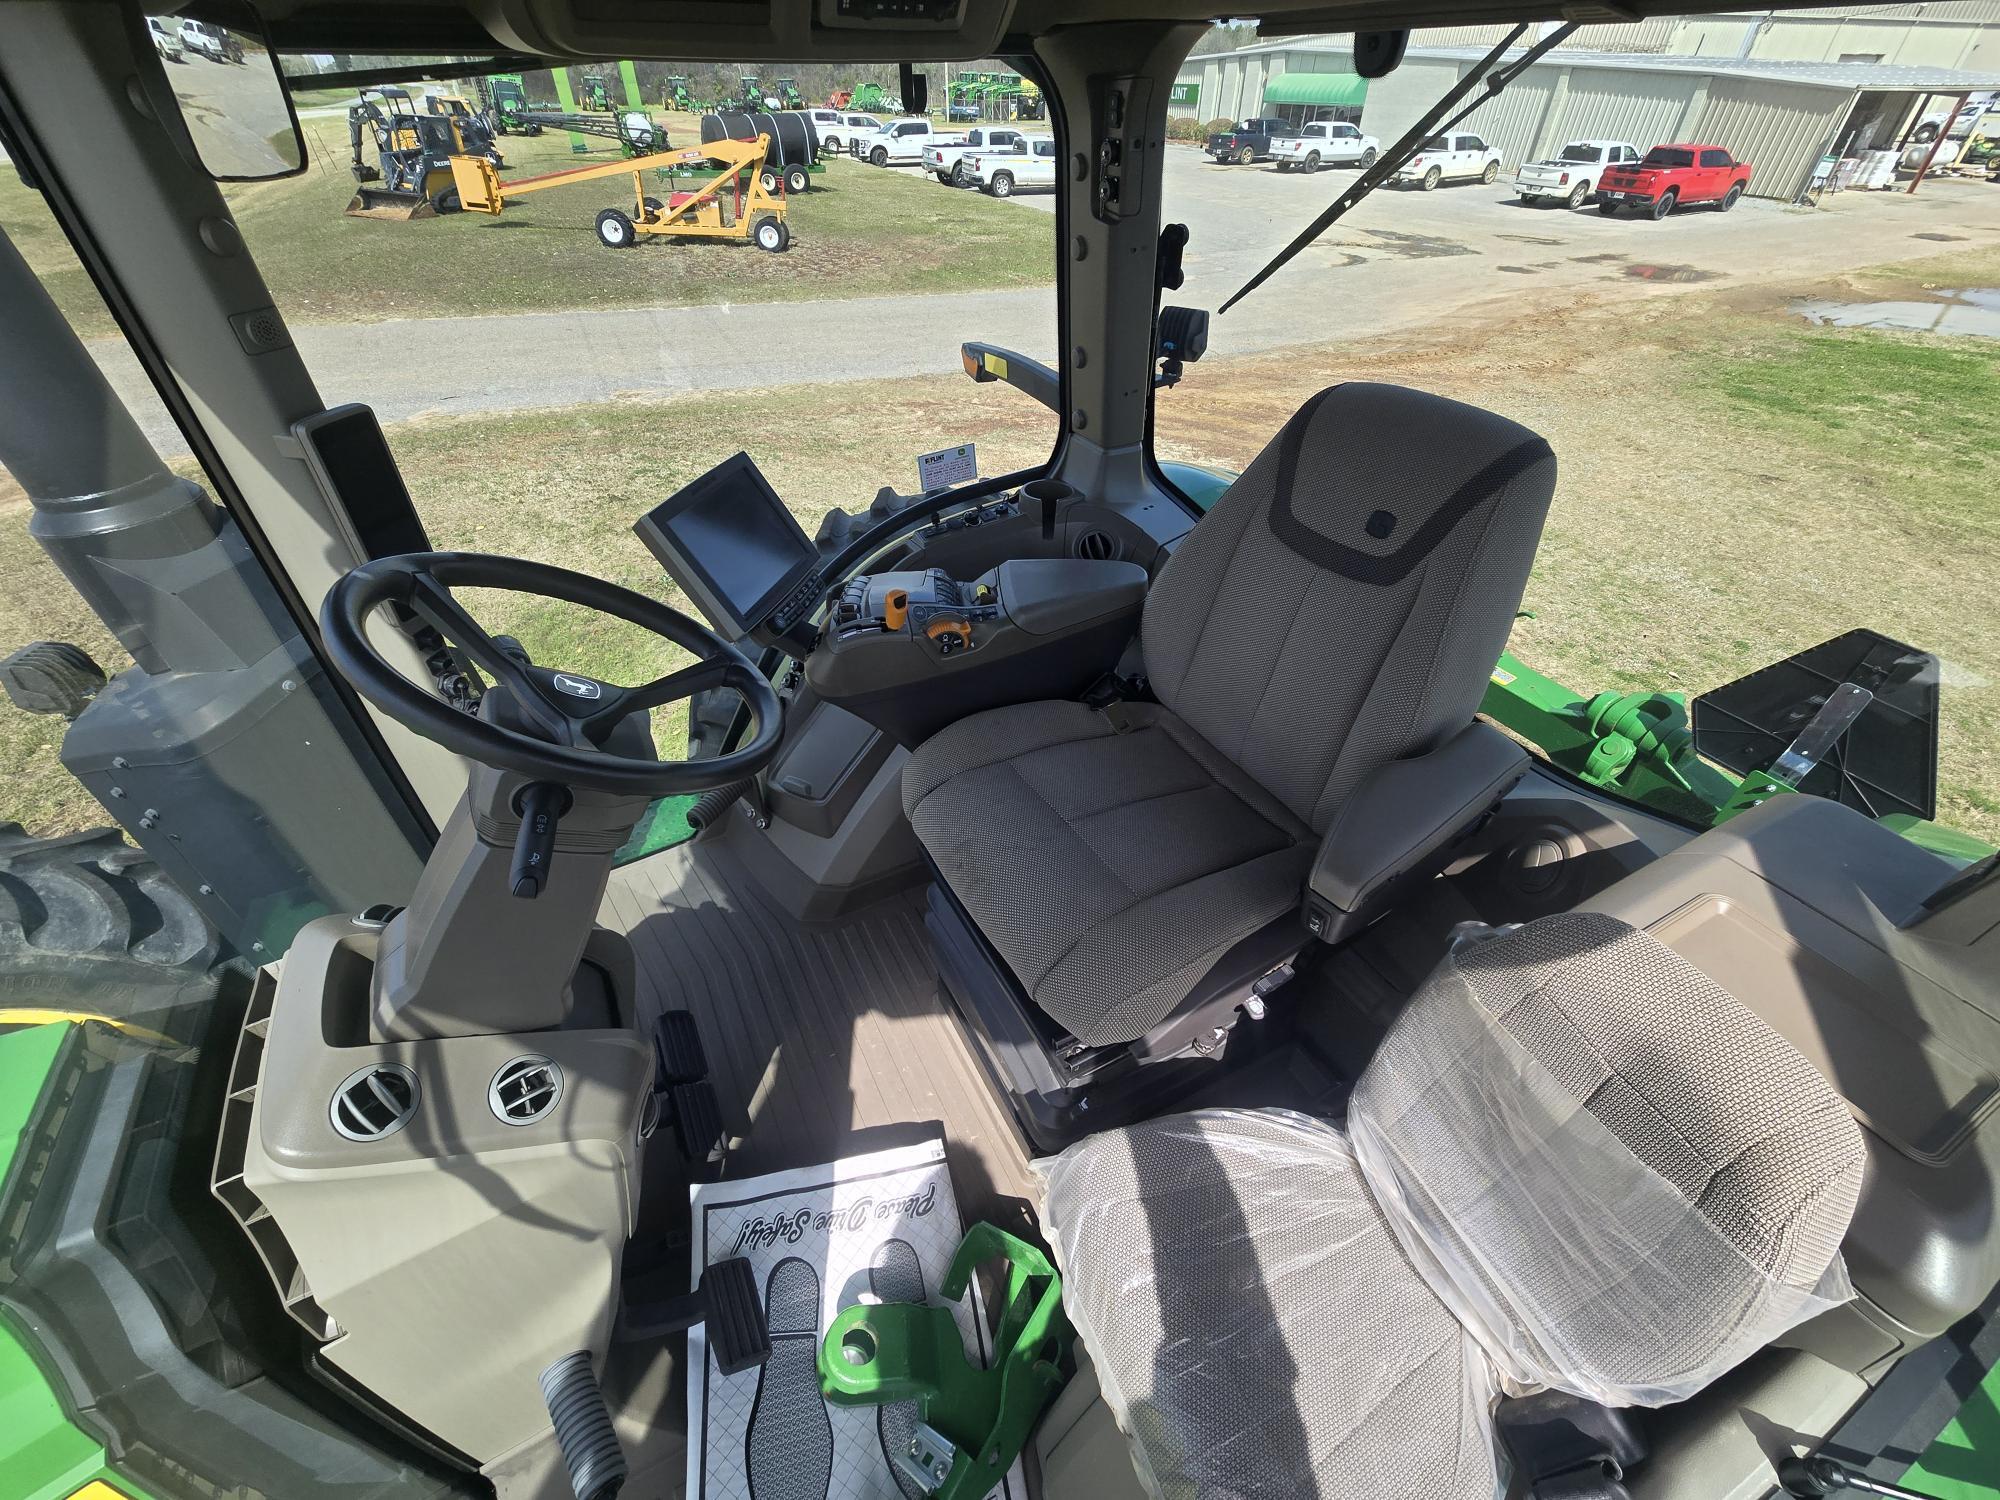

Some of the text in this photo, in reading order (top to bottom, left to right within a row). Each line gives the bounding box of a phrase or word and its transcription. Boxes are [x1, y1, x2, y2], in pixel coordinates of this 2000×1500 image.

[730, 1183, 936, 1256] Please Drive Safely!
